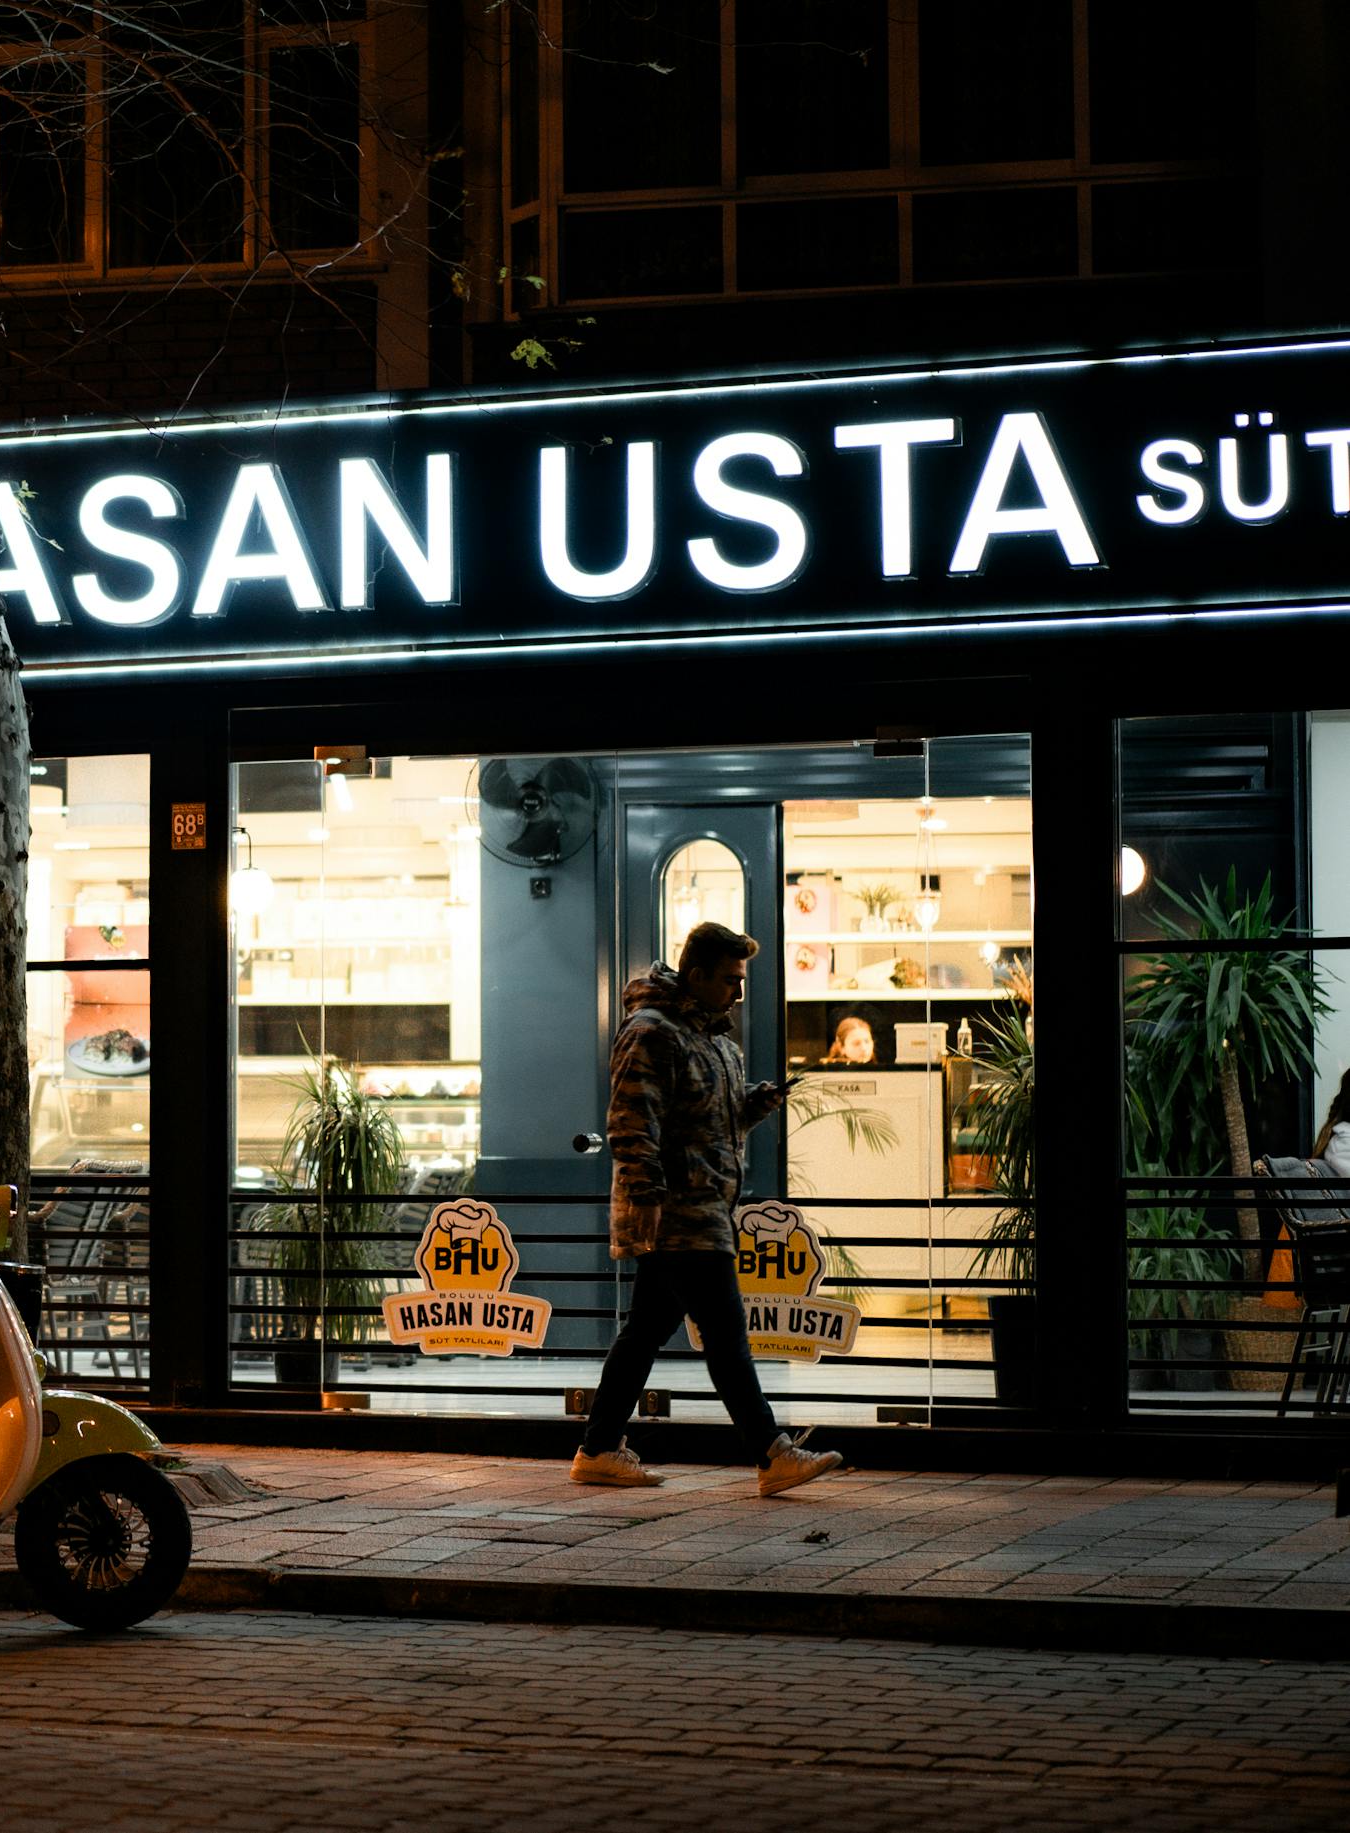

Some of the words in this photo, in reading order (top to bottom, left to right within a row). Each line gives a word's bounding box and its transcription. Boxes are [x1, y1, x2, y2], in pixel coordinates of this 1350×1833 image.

[537, 410, 1102, 600] USTA
[434, 1238, 499, 1276] BHU
[737, 1242, 807, 1280] BHU
[438, 1292, 495, 1300] BOLULU
[743, 1296, 801, 1305] BOLULU
[399, 1302, 473, 1331] HASAN
[482, 1302, 535, 1334] USTA
[788, 1307, 844, 1341] USTA
[453, 1336, 505, 1347] TATLILARI
[756, 1342, 812, 1354] TATLILARI
